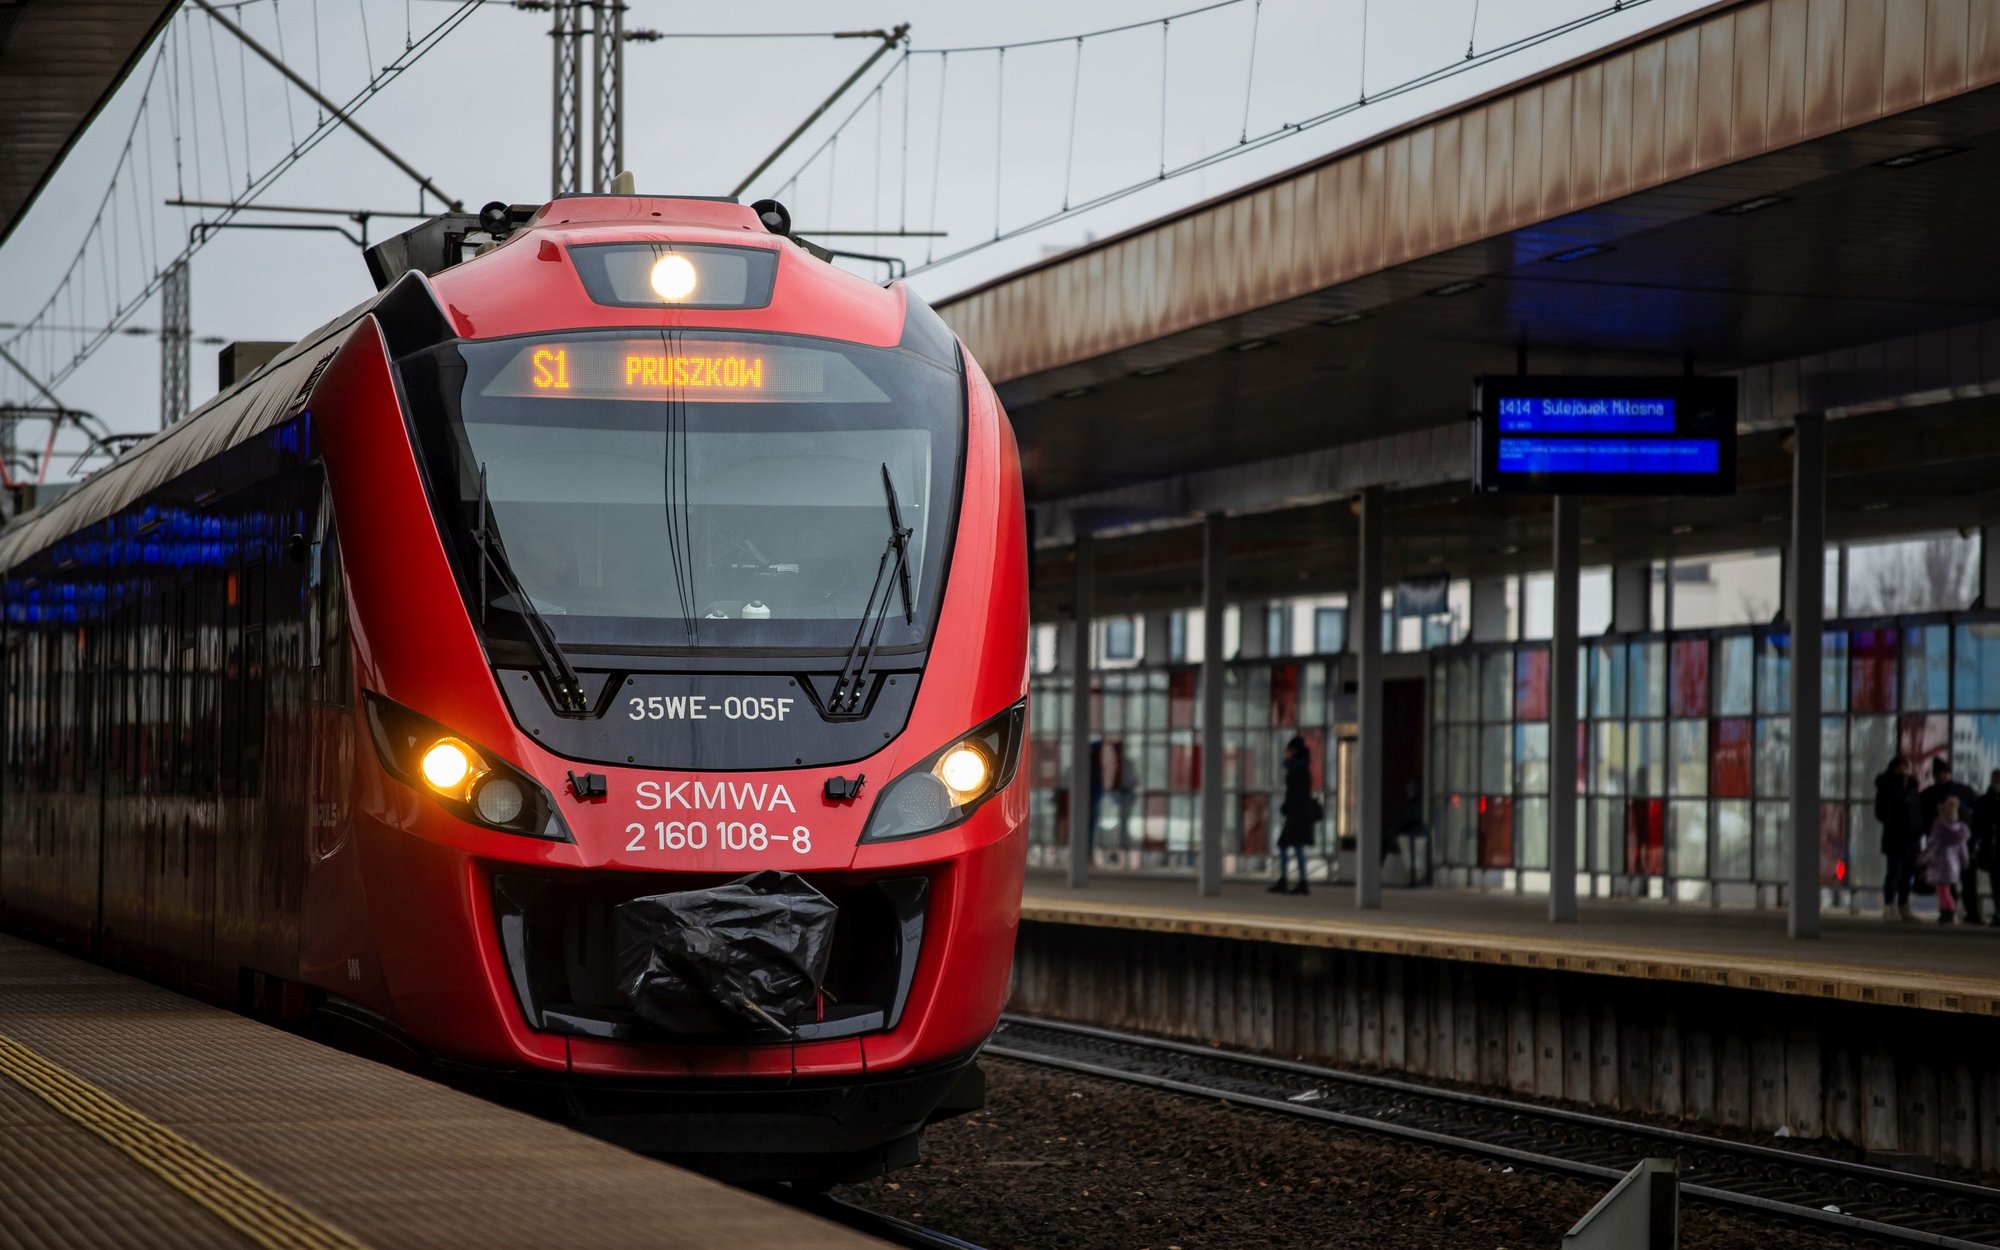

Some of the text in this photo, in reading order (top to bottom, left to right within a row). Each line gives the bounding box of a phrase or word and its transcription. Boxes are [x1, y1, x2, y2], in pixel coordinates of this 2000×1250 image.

[533, 350, 569, 388] S1
[628, 696, 794, 721] 35WE-005F
[635, 781, 797, 813] SKMWA
[625, 821, 812, 854] 2 160 108-8
